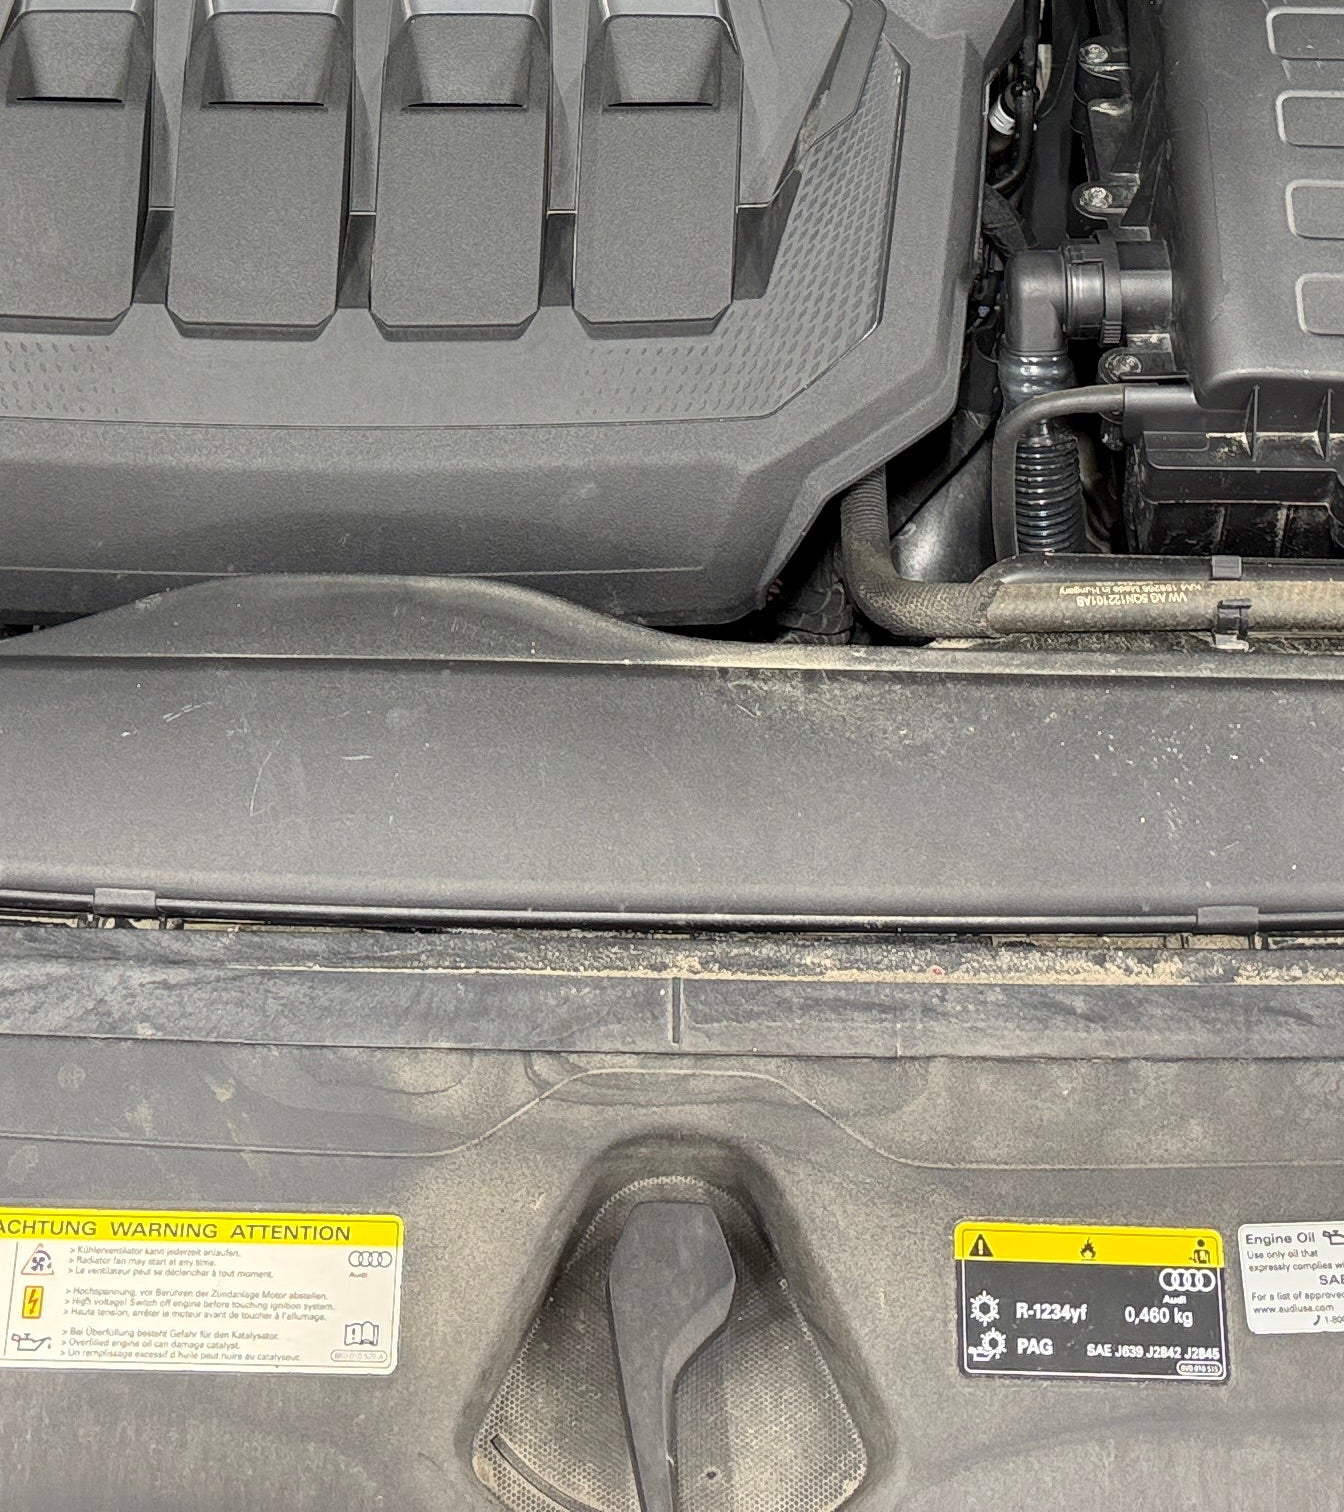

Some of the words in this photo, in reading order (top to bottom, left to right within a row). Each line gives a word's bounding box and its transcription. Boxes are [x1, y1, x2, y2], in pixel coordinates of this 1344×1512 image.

[1149, 592, 1167, 604] AG
[1168, 592, 1188, 603] VW
[111, 1222, 218, 1240] WARNING
[230, 1223, 351, 1242] ATTENTION
[1245, 1233, 1293, 1247] Engine
[1296, 1232, 1316, 1243] Oil
[1246, 1250, 1264, 1260] Use
[1266, 1250, 1285, 1260] only
[1300, 1249, 1319, 1259] that
[113, 1257, 127, 1265] fan
[128, 1258, 146, 1267] may
[1292, 1261, 1333, 1272] complies
[75, 1266, 85, 1275] Le
[261, 1291, 287, 1299] Motor
[1162, 1295, 1187, 1305] Audi
[1251, 1292, 1267, 1301] For
[159, 1299, 172, 1307] off
[172, 1300, 202, 1309] engine
[203, 1300, 230, 1309] before
[1015, 1302, 1088, 1324] R-1234yf
[1124, 1306, 1170, 1325] 0,460
[1173, 1307, 1194, 1328] kg
[1016, 1338, 1054, 1356] PAG
[1086, 1343, 1113, 1357] SAE
[1114, 1344, 1144, 1358] J639
[1145, 1345, 1182, 1359] J2842
[1184, 1345, 1221, 1360] J2845
